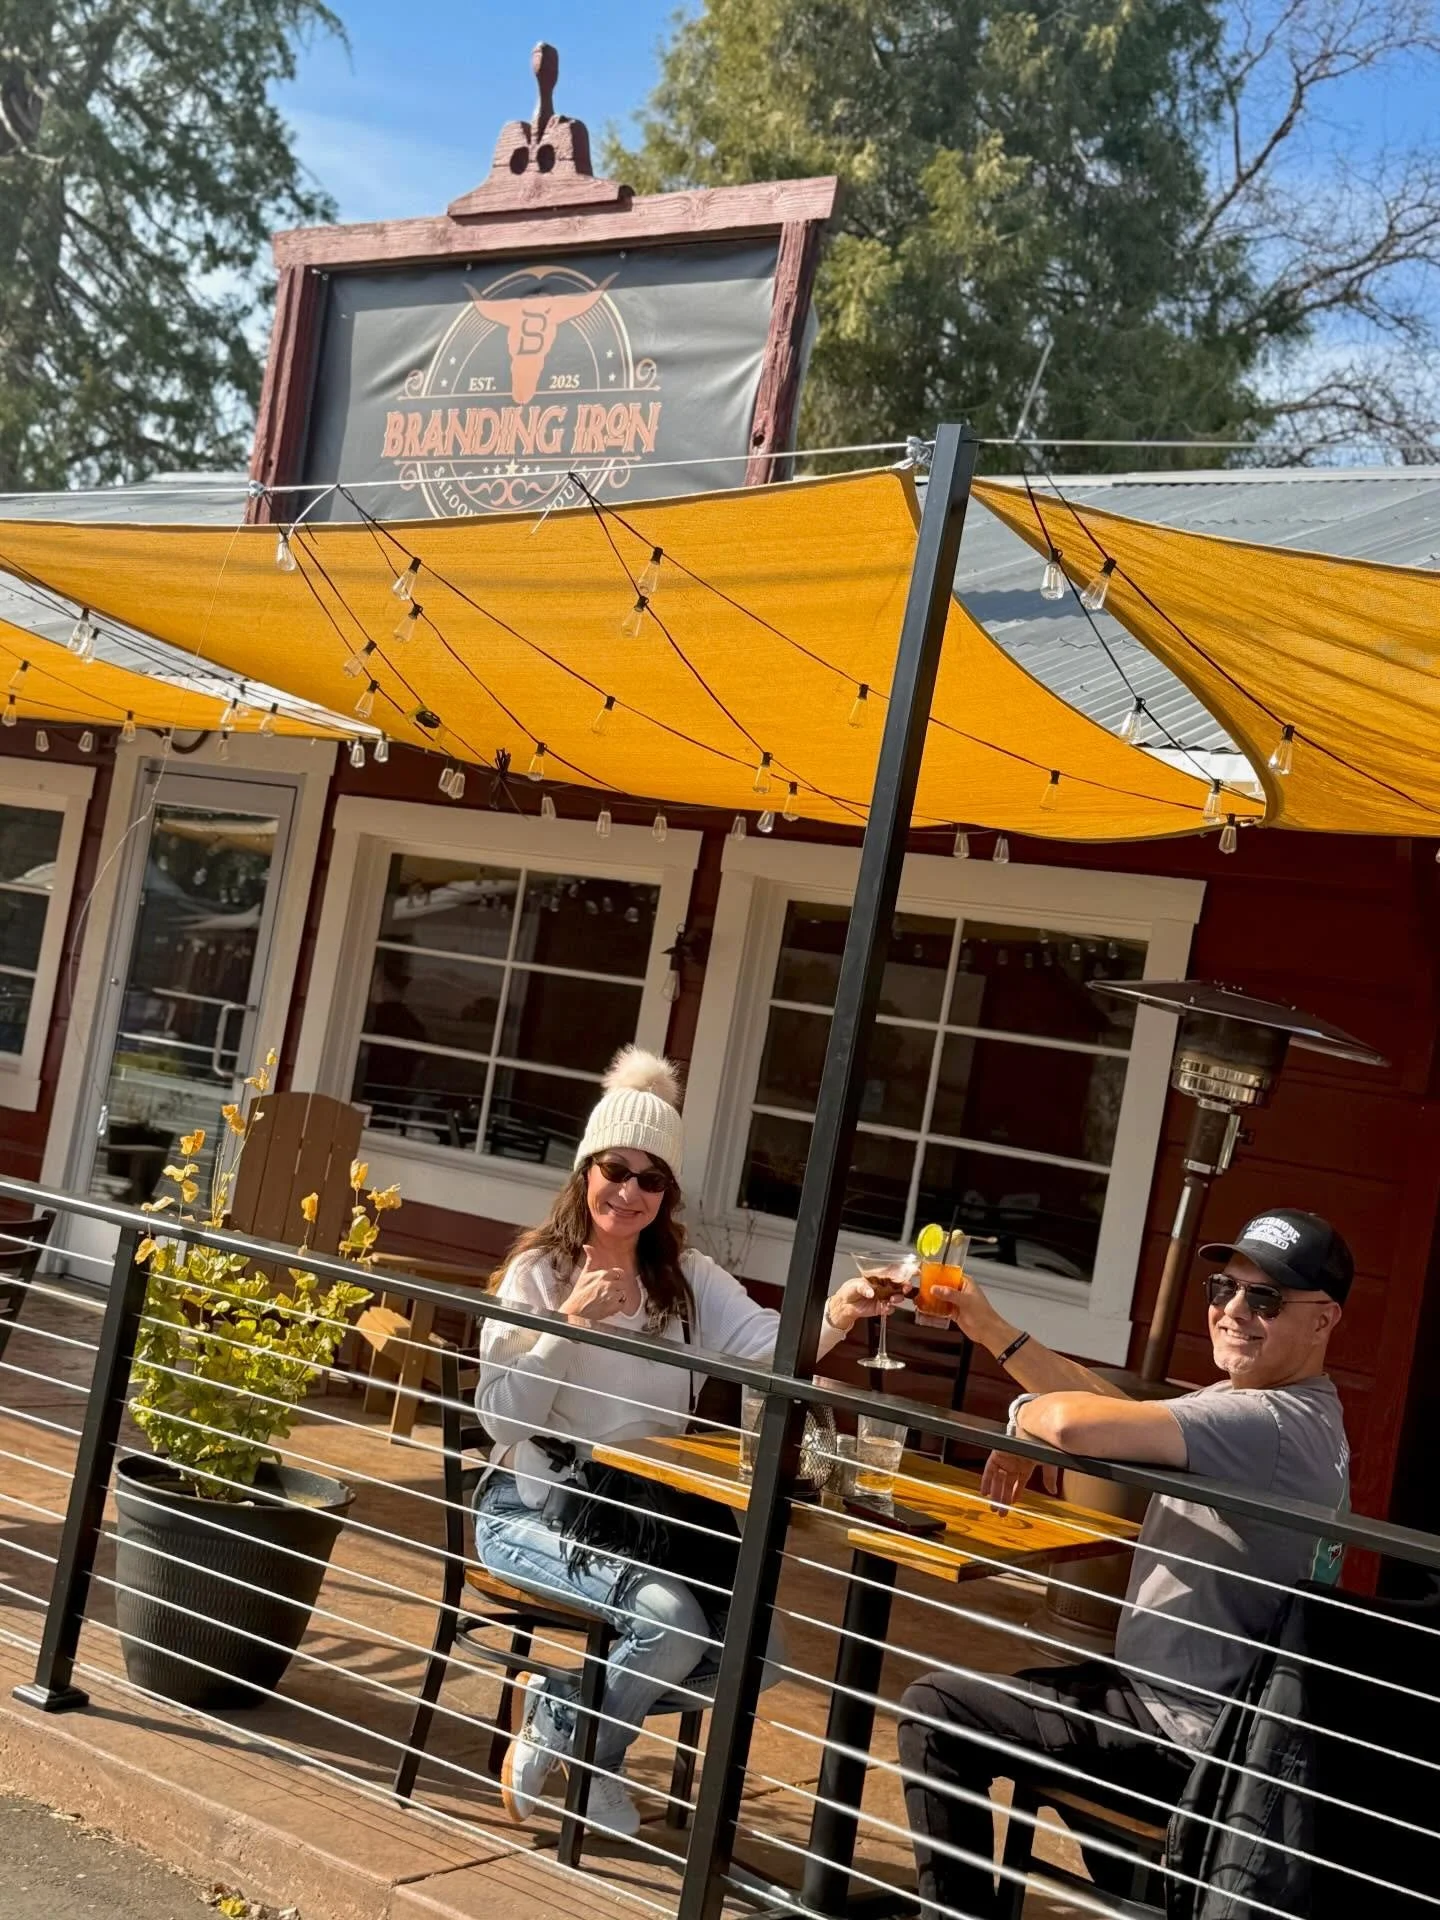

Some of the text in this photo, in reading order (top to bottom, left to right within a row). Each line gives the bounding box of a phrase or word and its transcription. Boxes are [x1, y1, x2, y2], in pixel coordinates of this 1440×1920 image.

[468, 374, 581, 392] EST. 2025
[380, 401, 663, 458] BRANDING IRON
[434, 466, 478, 516] SALOO
